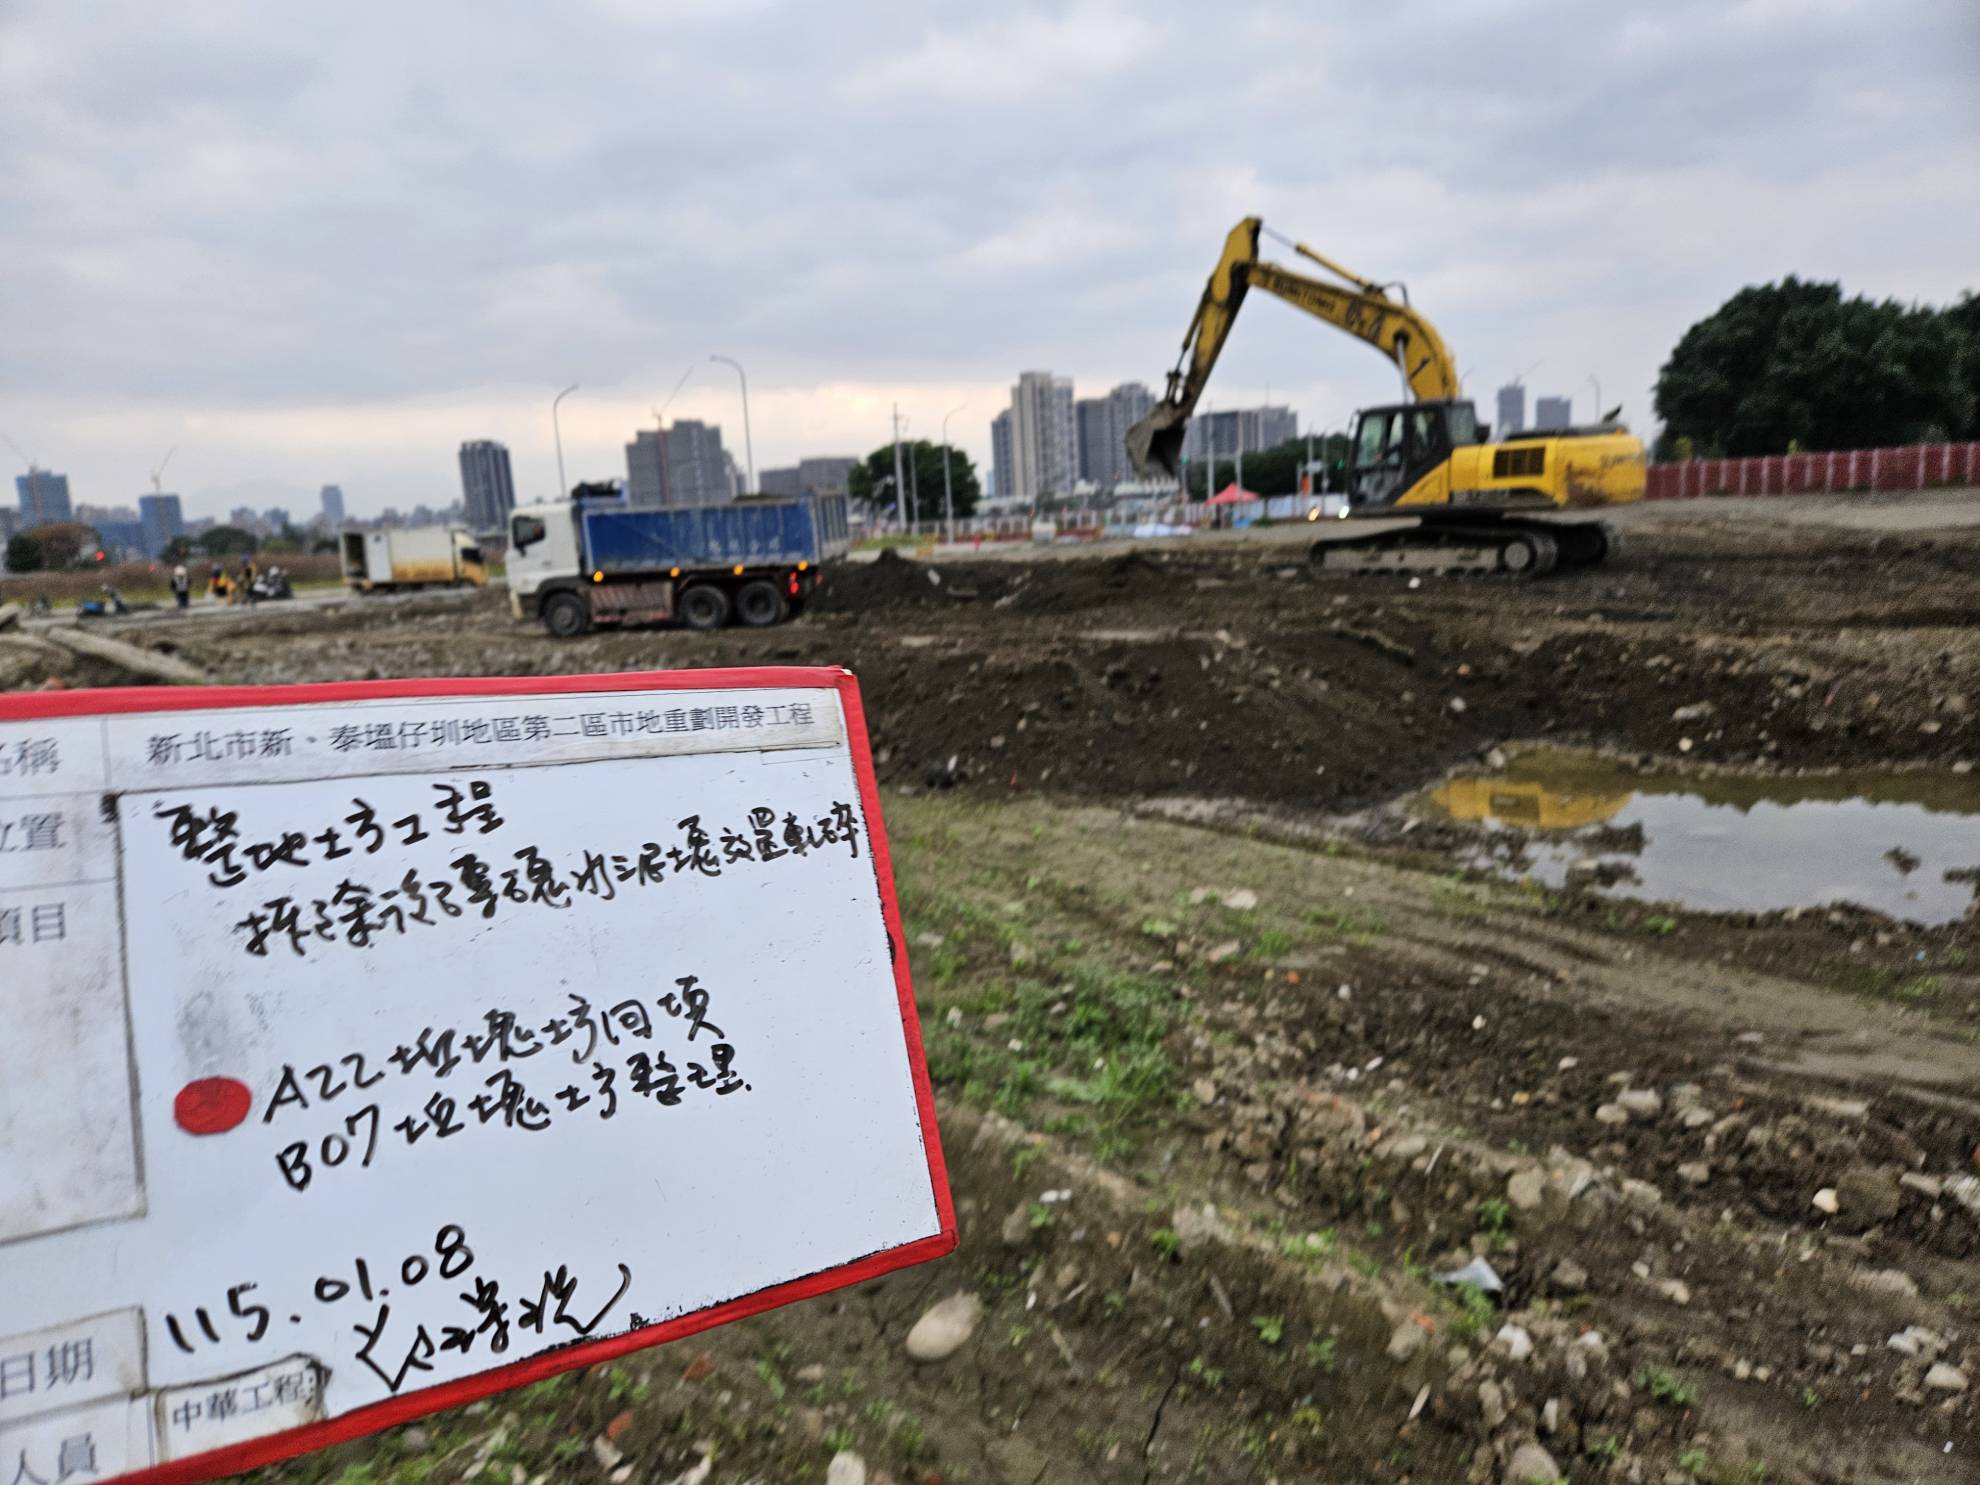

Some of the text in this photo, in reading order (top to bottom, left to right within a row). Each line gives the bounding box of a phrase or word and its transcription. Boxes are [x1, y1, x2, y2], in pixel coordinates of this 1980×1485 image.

[0, 737, 62, 777] 稱
[166, 1223, 475, 1354] 115.01.08
[0, 1336, 94, 1399] 日期
